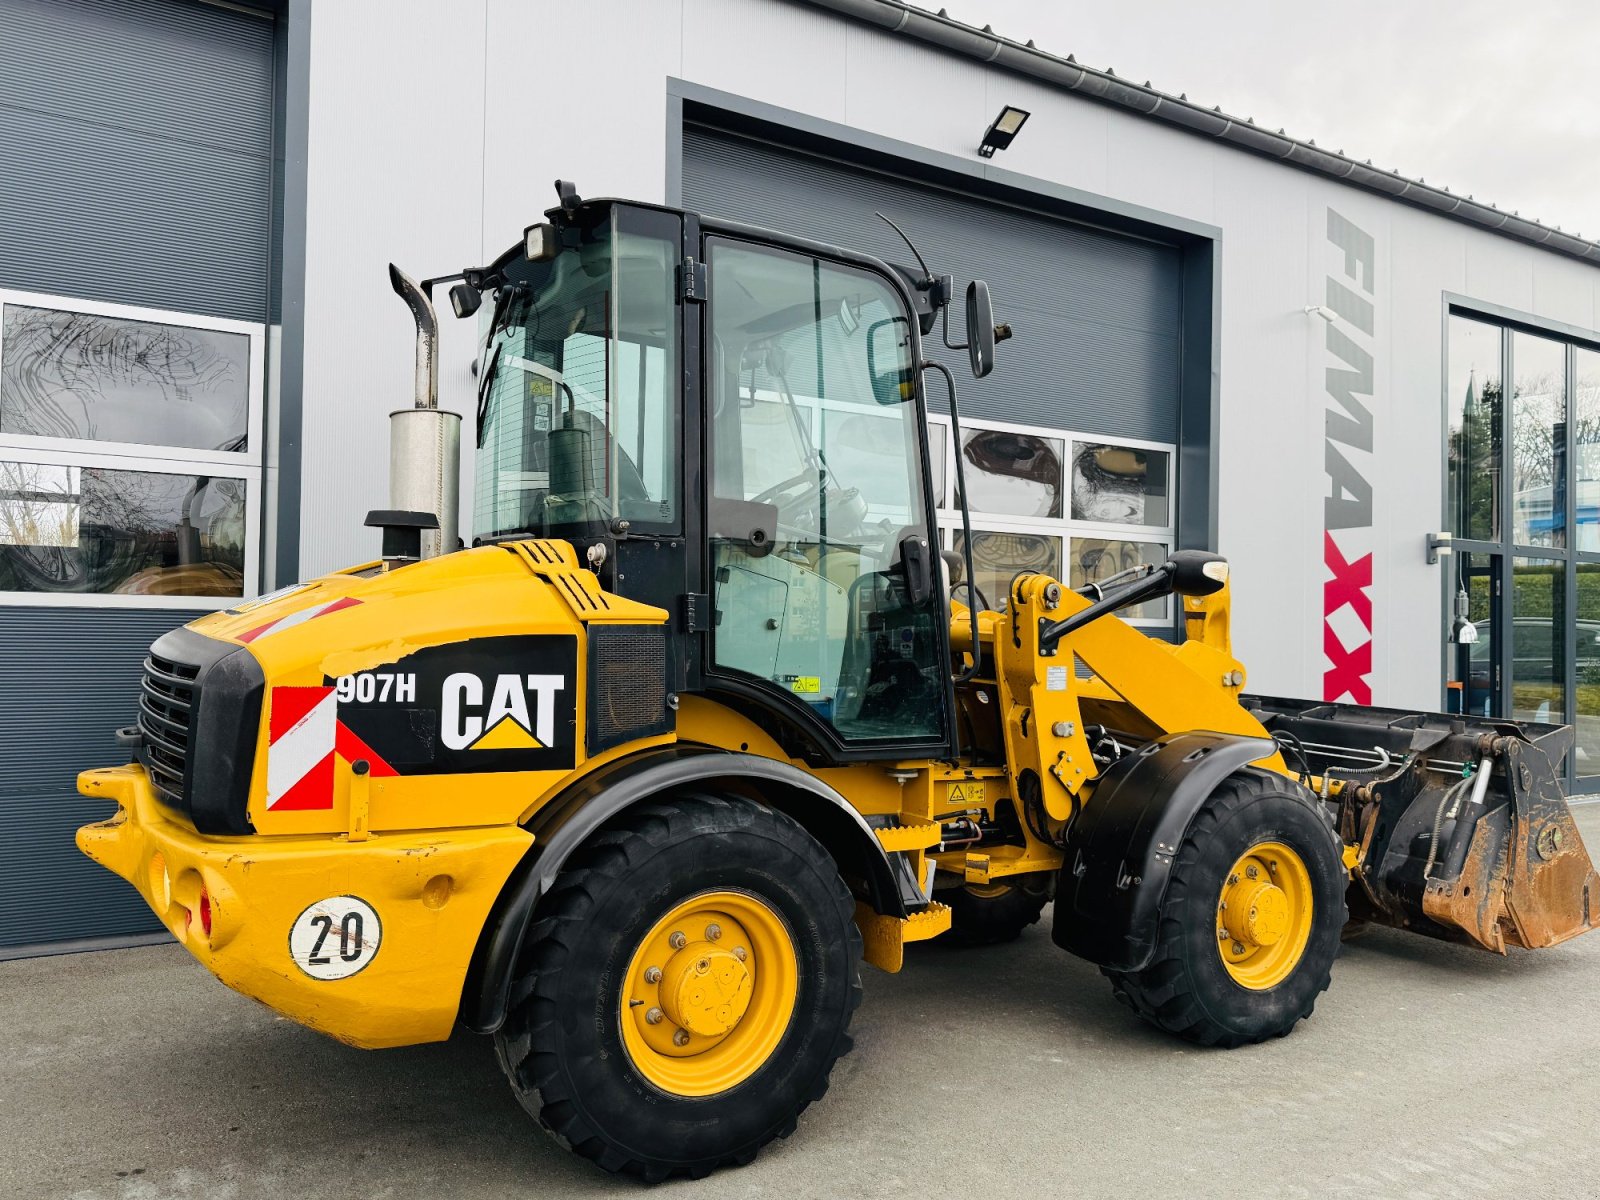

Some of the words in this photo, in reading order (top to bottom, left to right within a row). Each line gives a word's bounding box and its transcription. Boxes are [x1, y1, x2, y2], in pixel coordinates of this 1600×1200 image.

[1324, 206, 1374, 706] FIMAXX
[336, 672, 416, 703] 907H
[441, 672, 565, 750] CAT
[309, 911, 364, 966] 20
